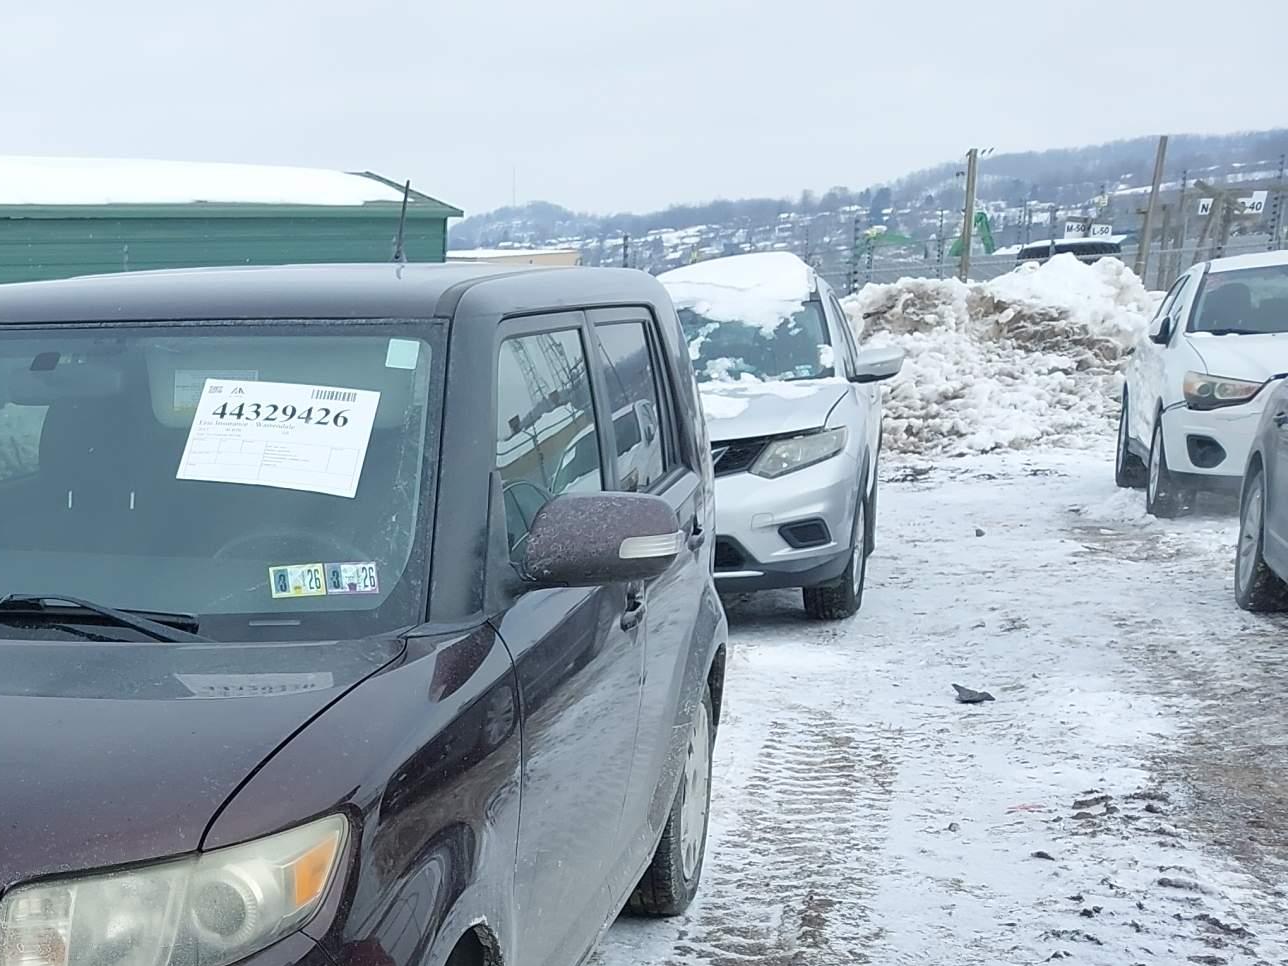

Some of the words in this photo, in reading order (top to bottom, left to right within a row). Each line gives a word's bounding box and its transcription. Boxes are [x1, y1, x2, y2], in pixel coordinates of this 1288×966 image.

[1066, 224, 1086, 233] M-50
[1092, 226, 1110, 236] L-50
[212, 402, 350, 427] 44329426
[278, 573, 287, 593] 3
[307, 568, 322, 590] 26
[332, 570, 341, 590] 3
[361, 566, 376, 588] 26
